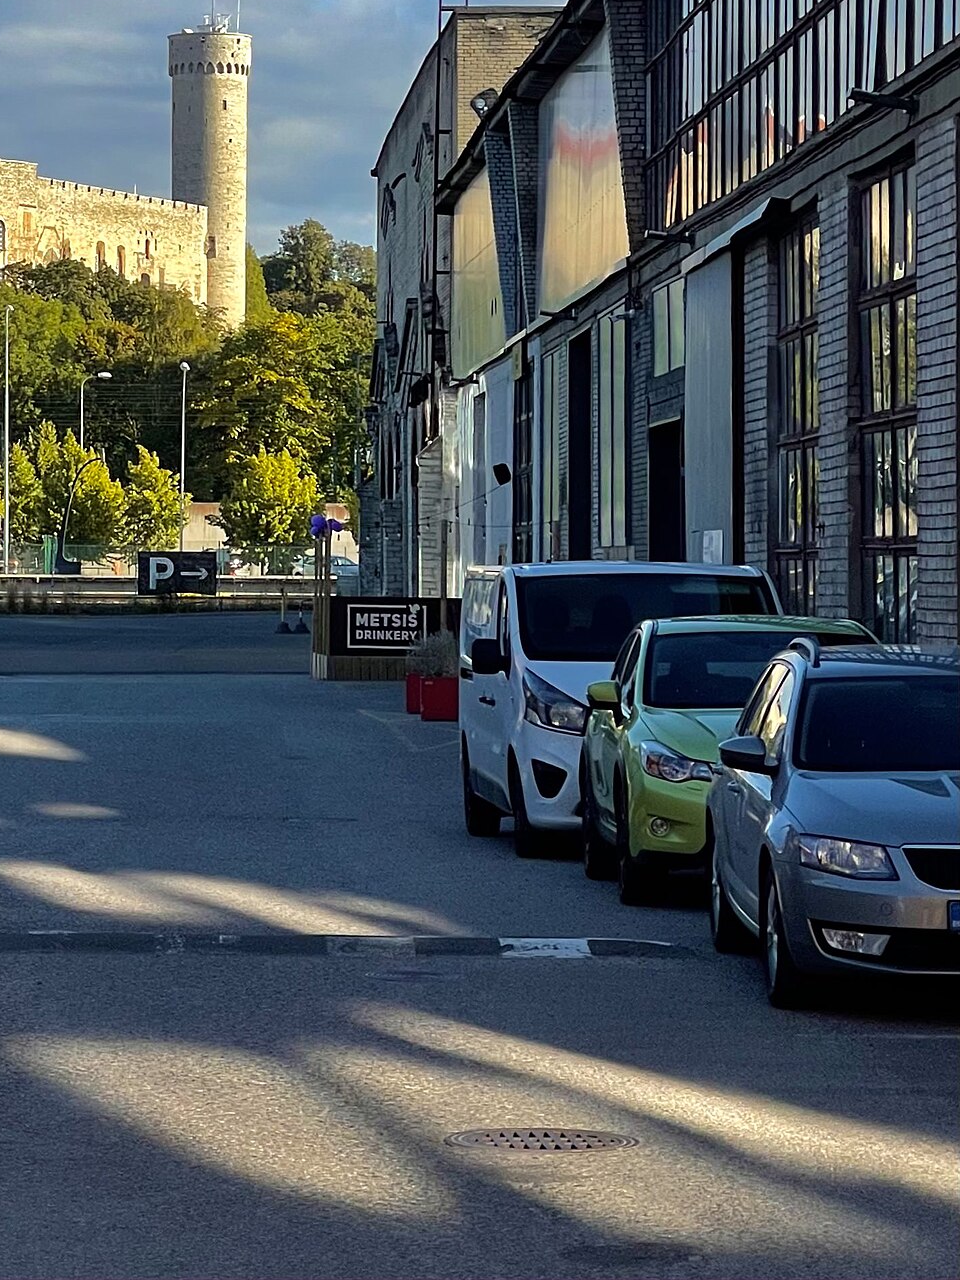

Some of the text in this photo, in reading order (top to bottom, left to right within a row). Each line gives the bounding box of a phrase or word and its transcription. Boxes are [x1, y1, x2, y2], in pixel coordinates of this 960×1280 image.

[149, 556, 175, 590] P
[355, 612, 418, 628] METSIS
[355, 629, 418, 641] DRINKERY
